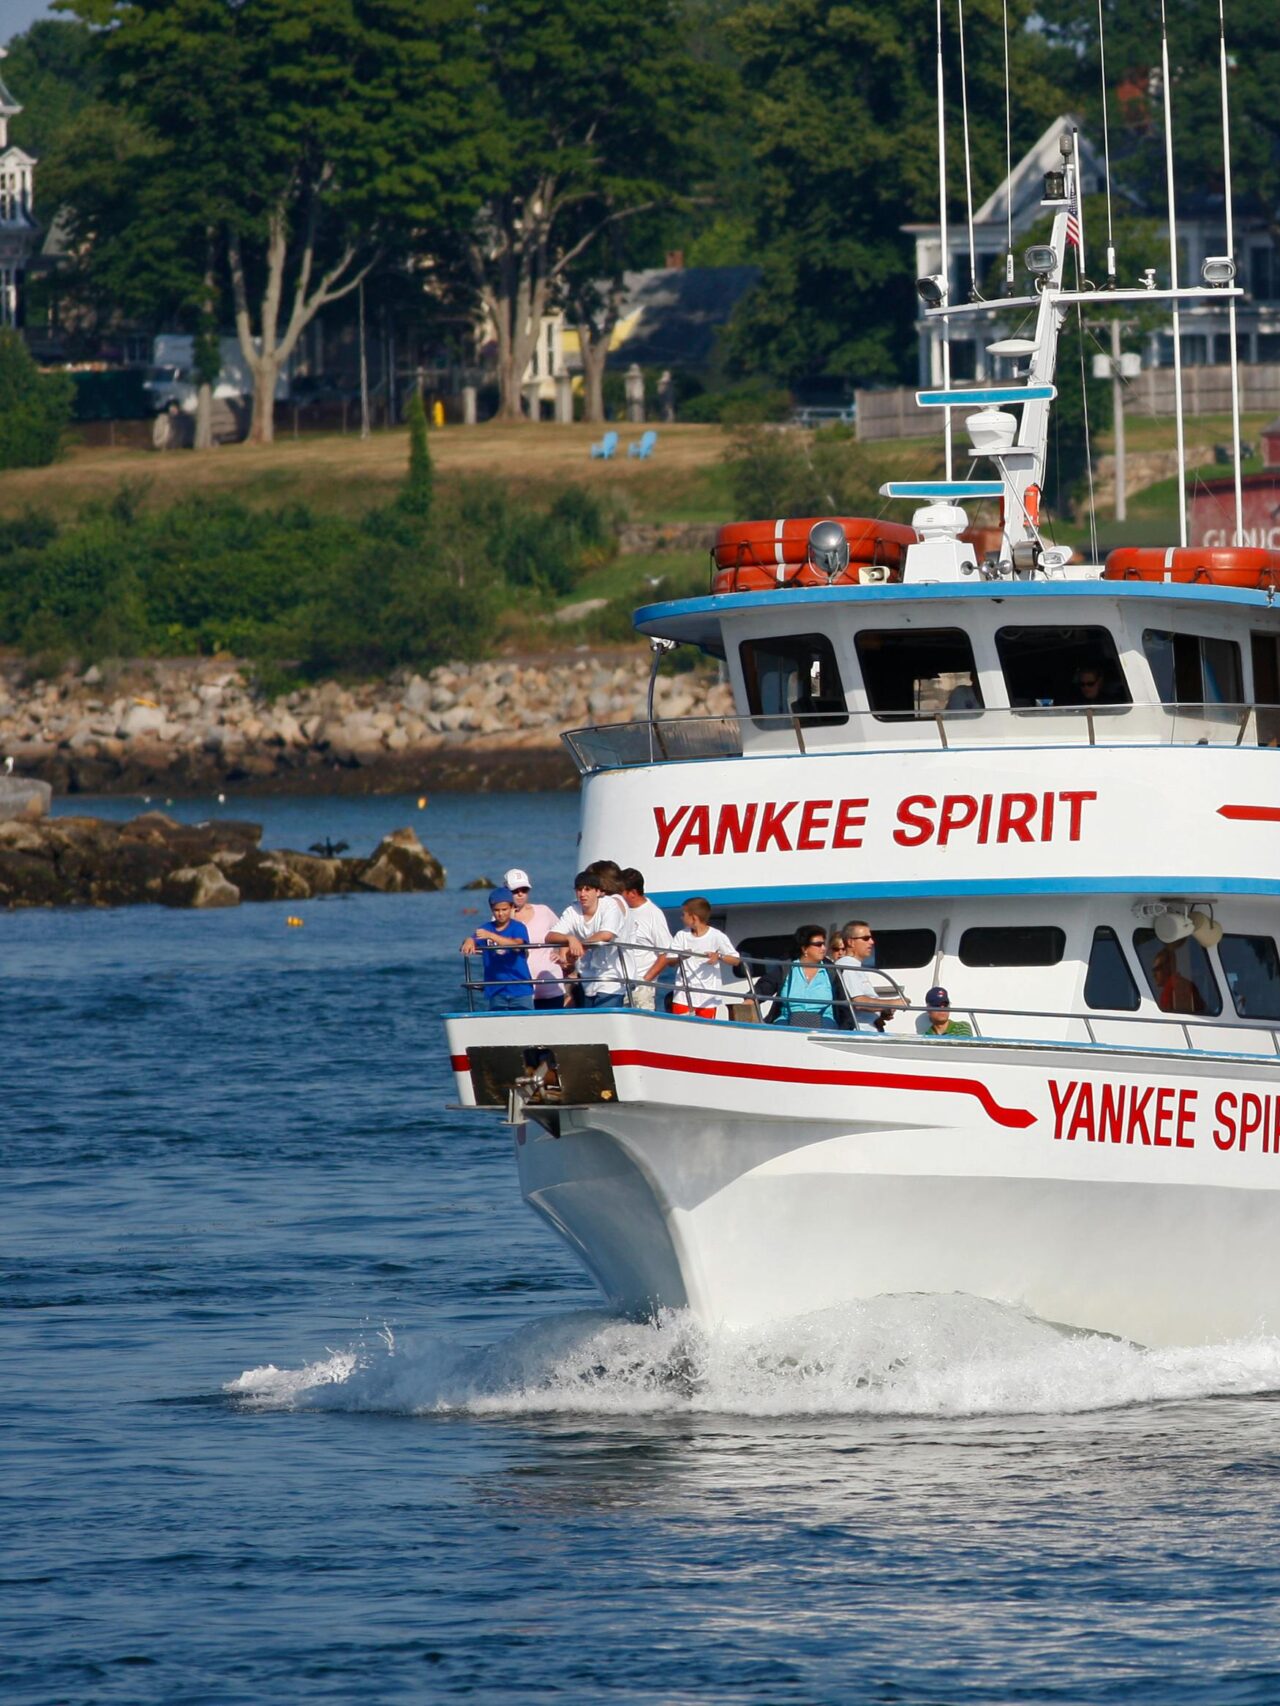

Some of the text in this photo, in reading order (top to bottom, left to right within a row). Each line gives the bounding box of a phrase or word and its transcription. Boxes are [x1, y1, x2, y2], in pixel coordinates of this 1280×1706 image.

[653, 790, 1098, 858] YANKEE SPIRIT
[1047, 1079, 1198, 1149] YANKEE
